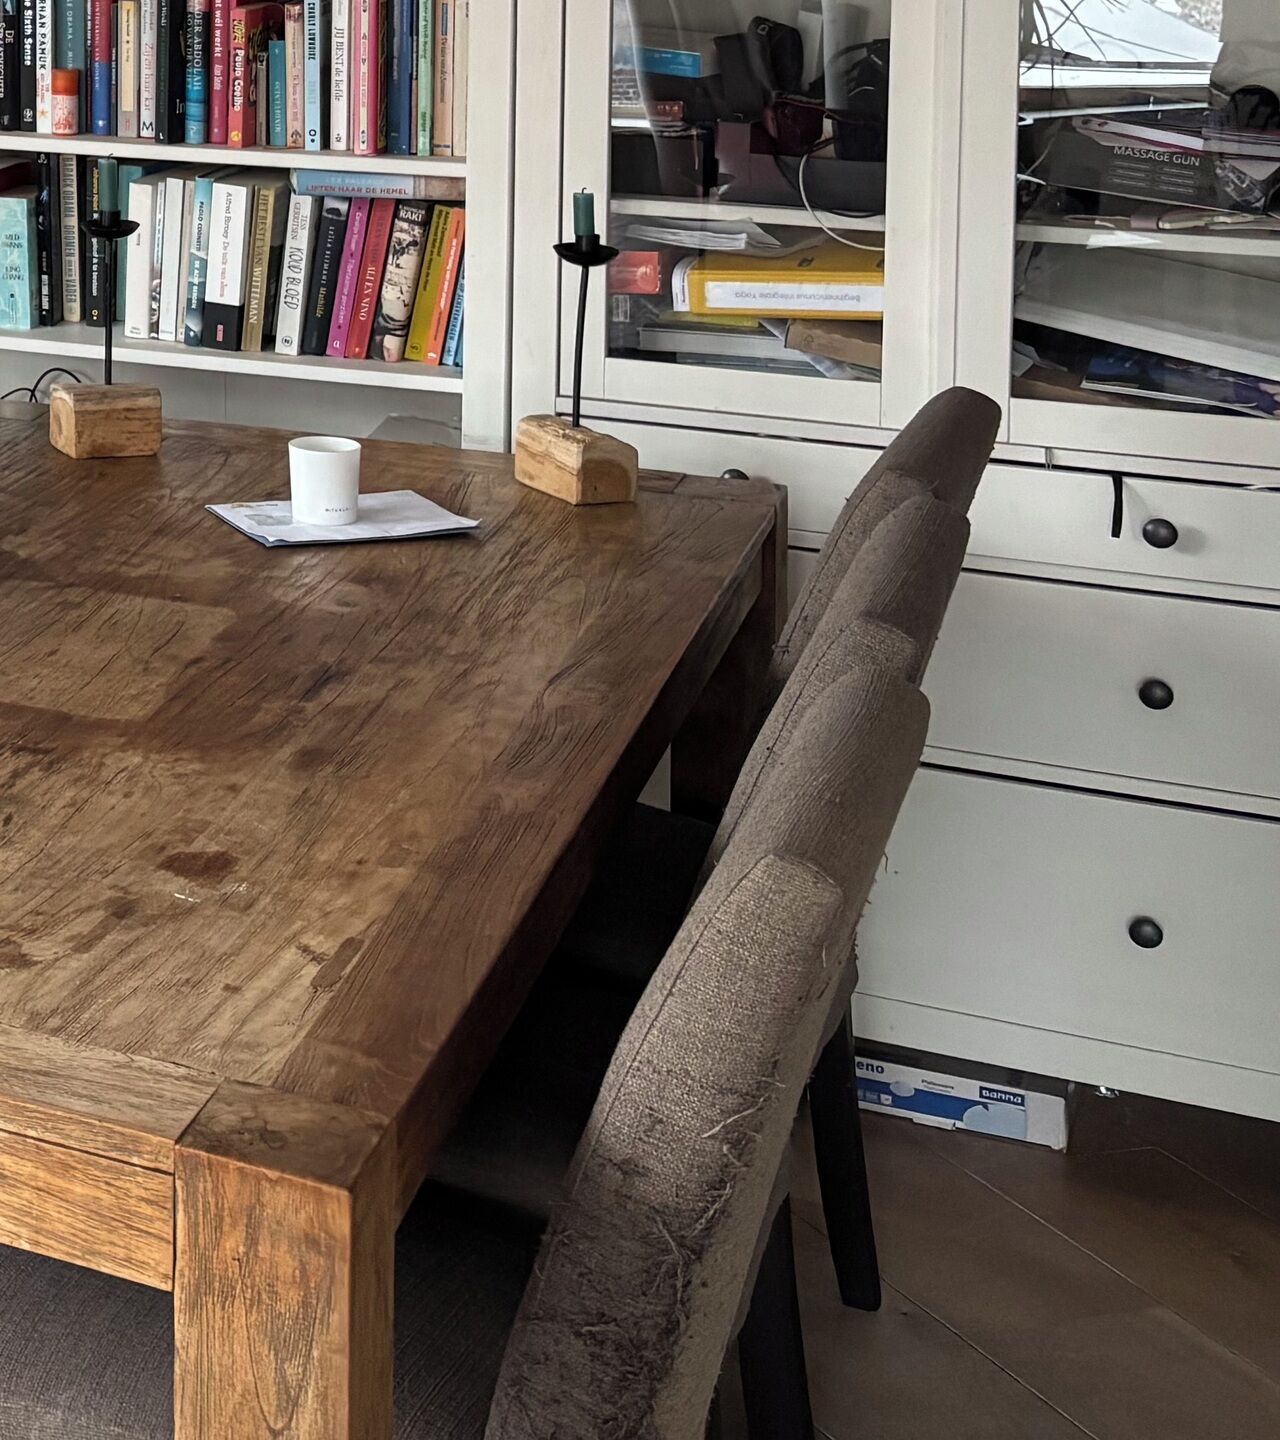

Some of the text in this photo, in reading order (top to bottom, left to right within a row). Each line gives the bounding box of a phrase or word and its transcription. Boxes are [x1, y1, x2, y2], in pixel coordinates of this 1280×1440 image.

[24, 10, 33, 35] Sixth
[215, 10, 223, 26] wél
[307, 2, 316, 26] CHARLY
[5, 30, 15, 43] DE
[214, 30, 222, 57] werkt
[24, 38, 32, 66] Sense
[193, 37, 202, 90] ABDOLAH
[234, 49, 244, 77] Paulo
[334, 27, 344, 102] JIJ BENT de liefde
[145, 73, 154, 111] haar kat
[233, 80, 243, 112] Coelho
[1114, 146, 1200, 166] MASSAGE GUN
[225, 192, 233, 214] Alfred
[399, 210, 422, 221] RAKI
[63, 157, 75, 303] BARACK OBAMA DROMEN VADER
[290, 202, 301, 240] GERRITSEN
[300, 215, 308, 230] TESS
[223, 241, 230, 251] De
[249, 194, 268, 324] HET BESTE VAN WITTEMAN
[284, 247, 304, 309] KOUD BLOED
[358, 264, 375, 320] ALI EN NINO
[315, 287, 327, 318] Mathilde
